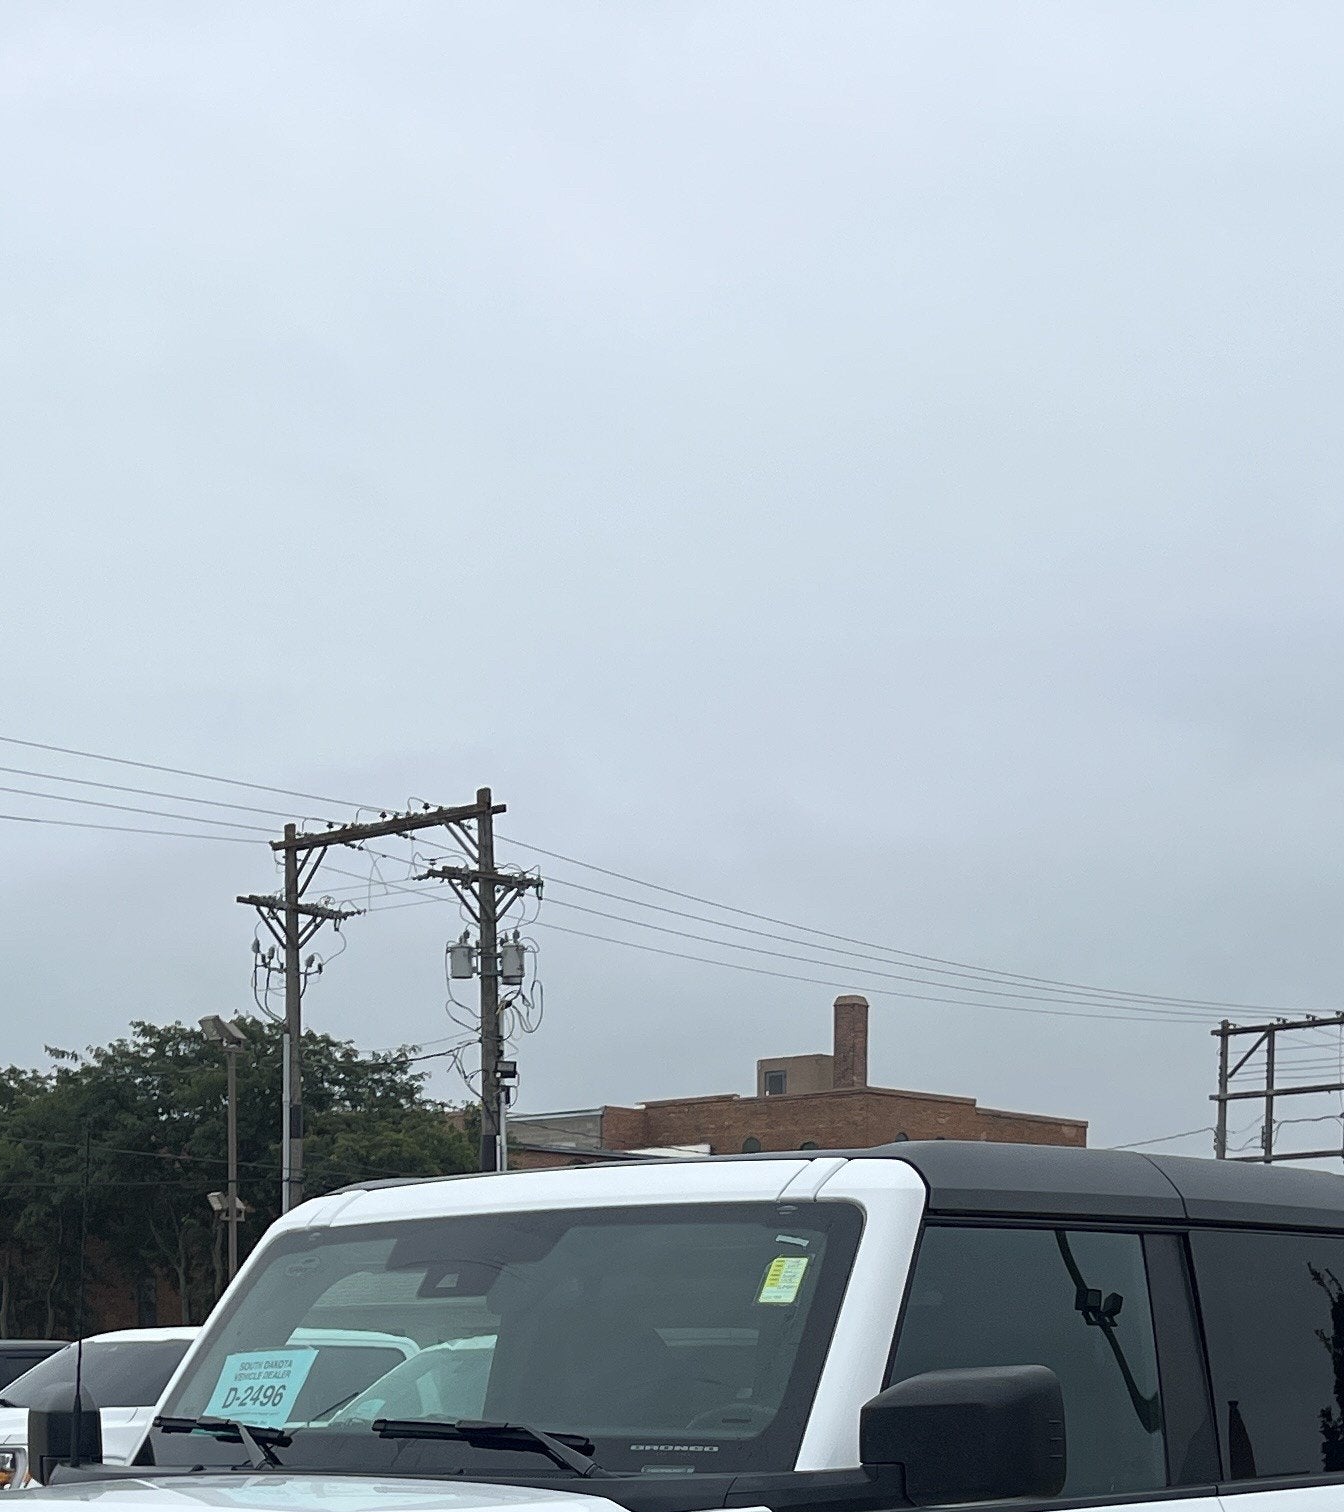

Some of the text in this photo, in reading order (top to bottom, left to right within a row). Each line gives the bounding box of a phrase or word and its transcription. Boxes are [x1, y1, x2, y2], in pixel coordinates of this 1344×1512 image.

[239, 1359, 294, 1371] SOUTH DAKOTA
[235, 1370, 292, 1381] VEHICLE DEALER
[222, 1384, 287, 1409] D-2496
[630, 1444, 719, 1452] BRONCO
